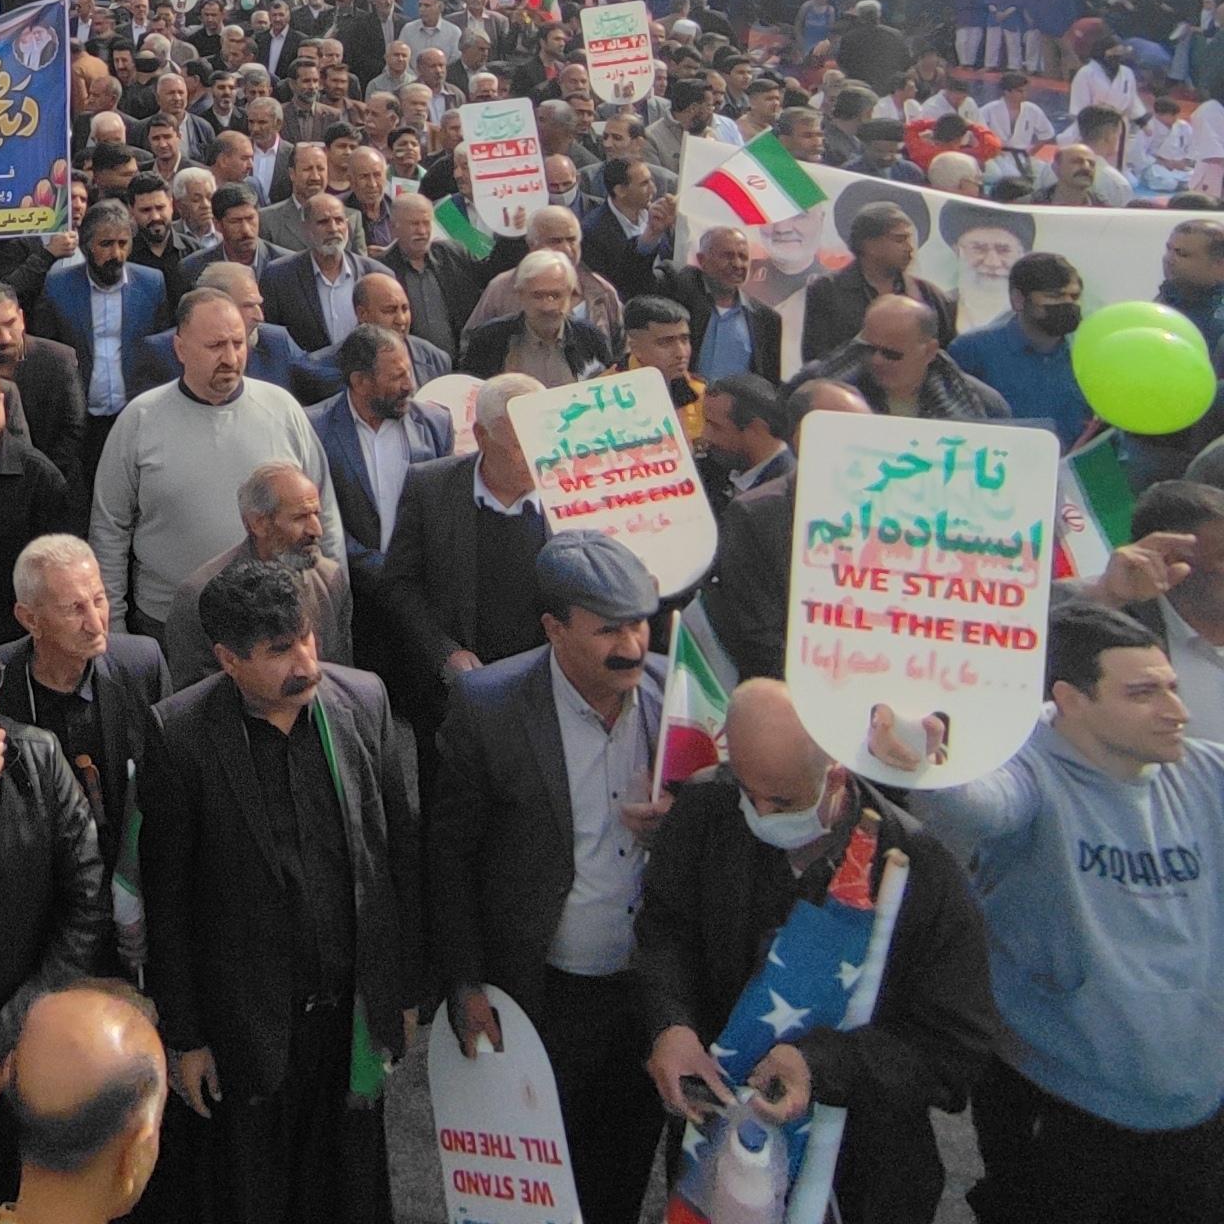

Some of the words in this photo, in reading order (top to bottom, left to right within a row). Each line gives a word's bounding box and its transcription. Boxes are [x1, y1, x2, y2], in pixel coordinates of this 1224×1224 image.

[6, 190, 13, 202] و
[18, 210, 48, 226] شرکت
[557, 384, 606, 433] آخر
[612, 383, 637, 409] تا
[559, 474, 596, 494] WE
[602, 459, 678, 486] STAND
[862, 436, 968, 492] آخر
[974, 446, 1009, 490] تا
[550, 500, 597, 520] TILL
[602, 490, 647, 510] THE
[648, 478, 696, 503] END
[832, 563, 891, 592] WE
[902, 574, 1026, 608] STAND
[801, 600, 873, 631] TILL
[886, 609, 955, 642] THE
[961, 620, 1038, 651] END
[440, 1128, 477, 1154] END
[477, 1132, 517, 1159] THE
[519, 1136, 563, 1165] TILL
[452, 1169, 515, 1201] STAND
[519, 1178, 555, 1208] WE
